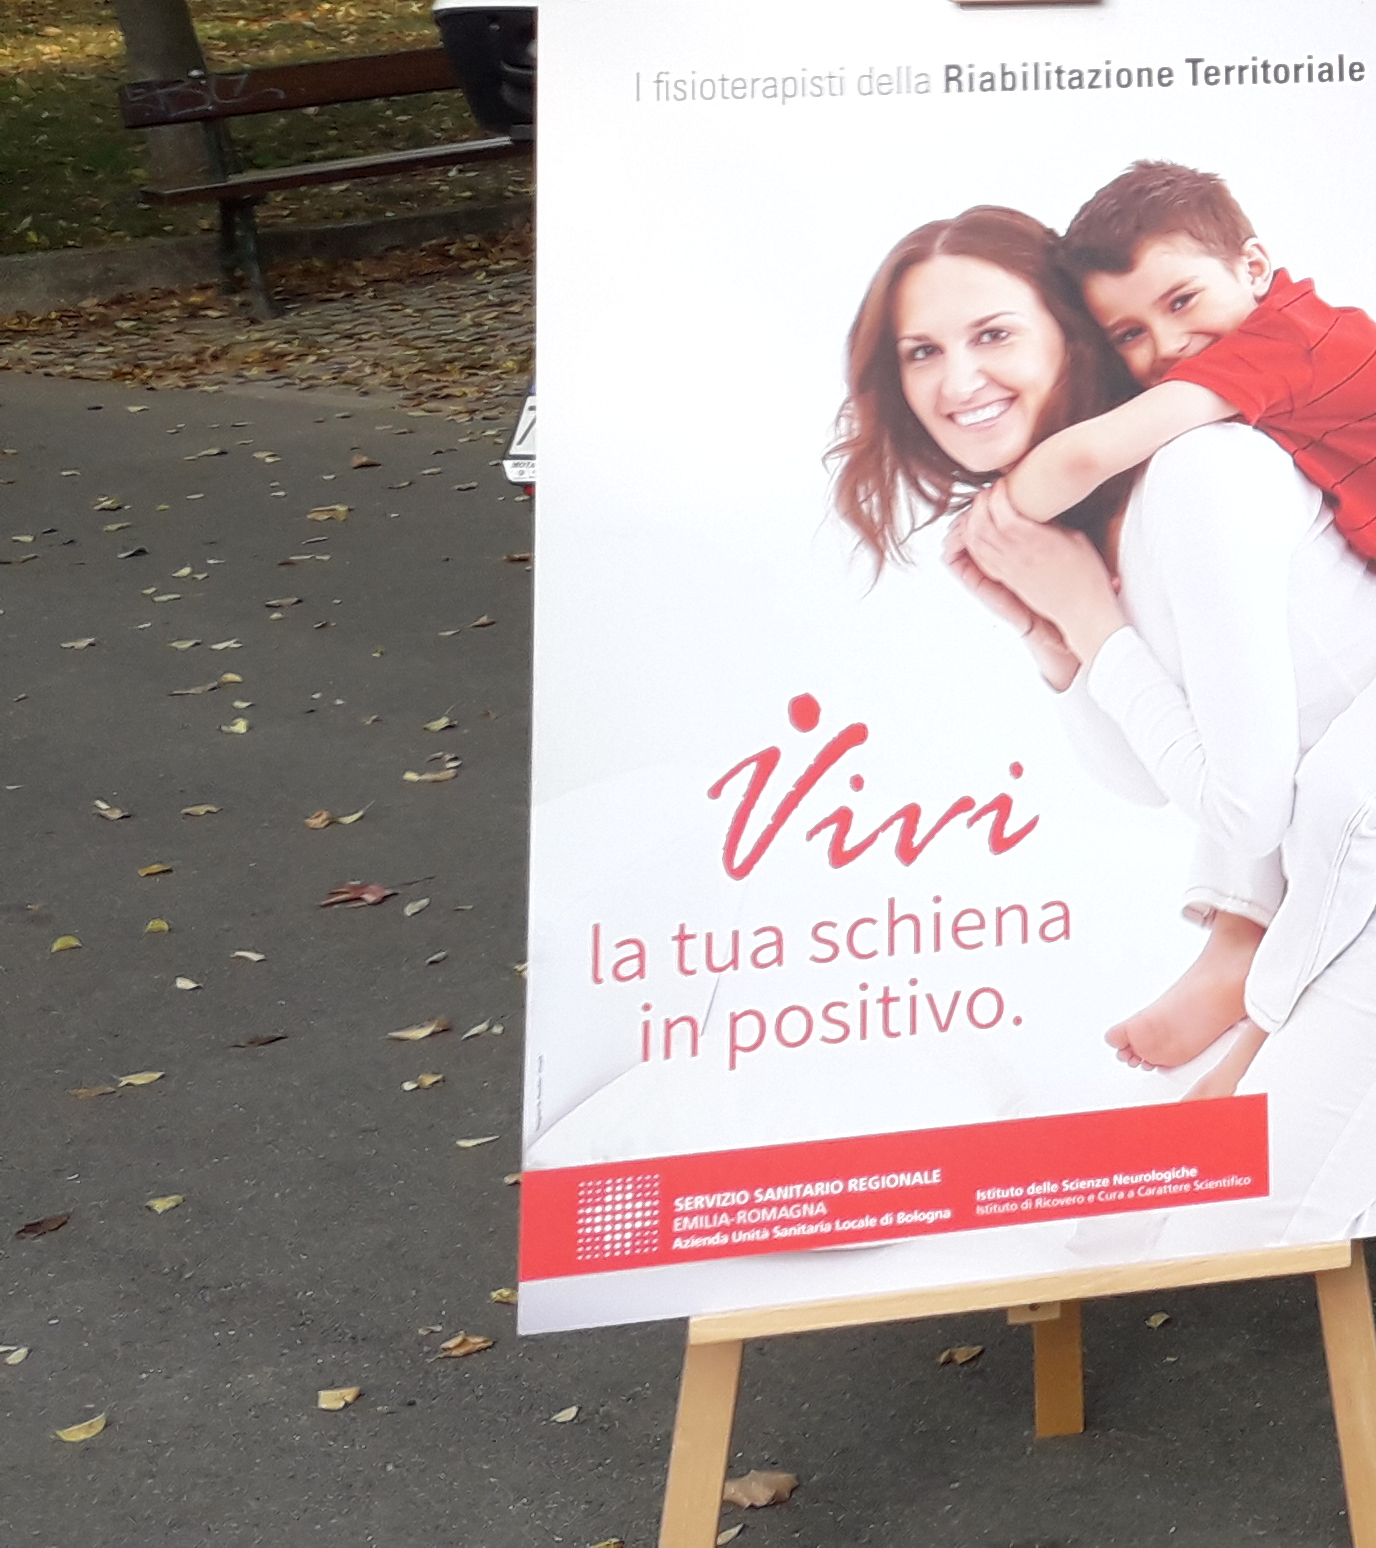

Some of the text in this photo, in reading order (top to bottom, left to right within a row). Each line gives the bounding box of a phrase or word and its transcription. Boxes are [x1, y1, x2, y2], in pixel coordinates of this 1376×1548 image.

[635, 53, 1366, 105] I fisioterapisti della Riabilitazione Territoriale
[706, 692, 1040, 881] Vivi
[590, 895, 1071, 984] la tua schiena
[639, 977, 1023, 1071] in positivo.
[673, 1168, 943, 1212] SERVIZIO SANITARIO REGIONALE
[976, 1165, 1198, 1202] Istituto delle Scienze Neurologiche
[976, 1175, 1252, 1216] Istituto di Ricovero e Cura a Carattere Scientifico
[673, 1201, 828, 1232] EMILIA-ROMAGNA
[673, 1208, 951, 1250] Azienda Unità Sanitaria Locale di Bologna
